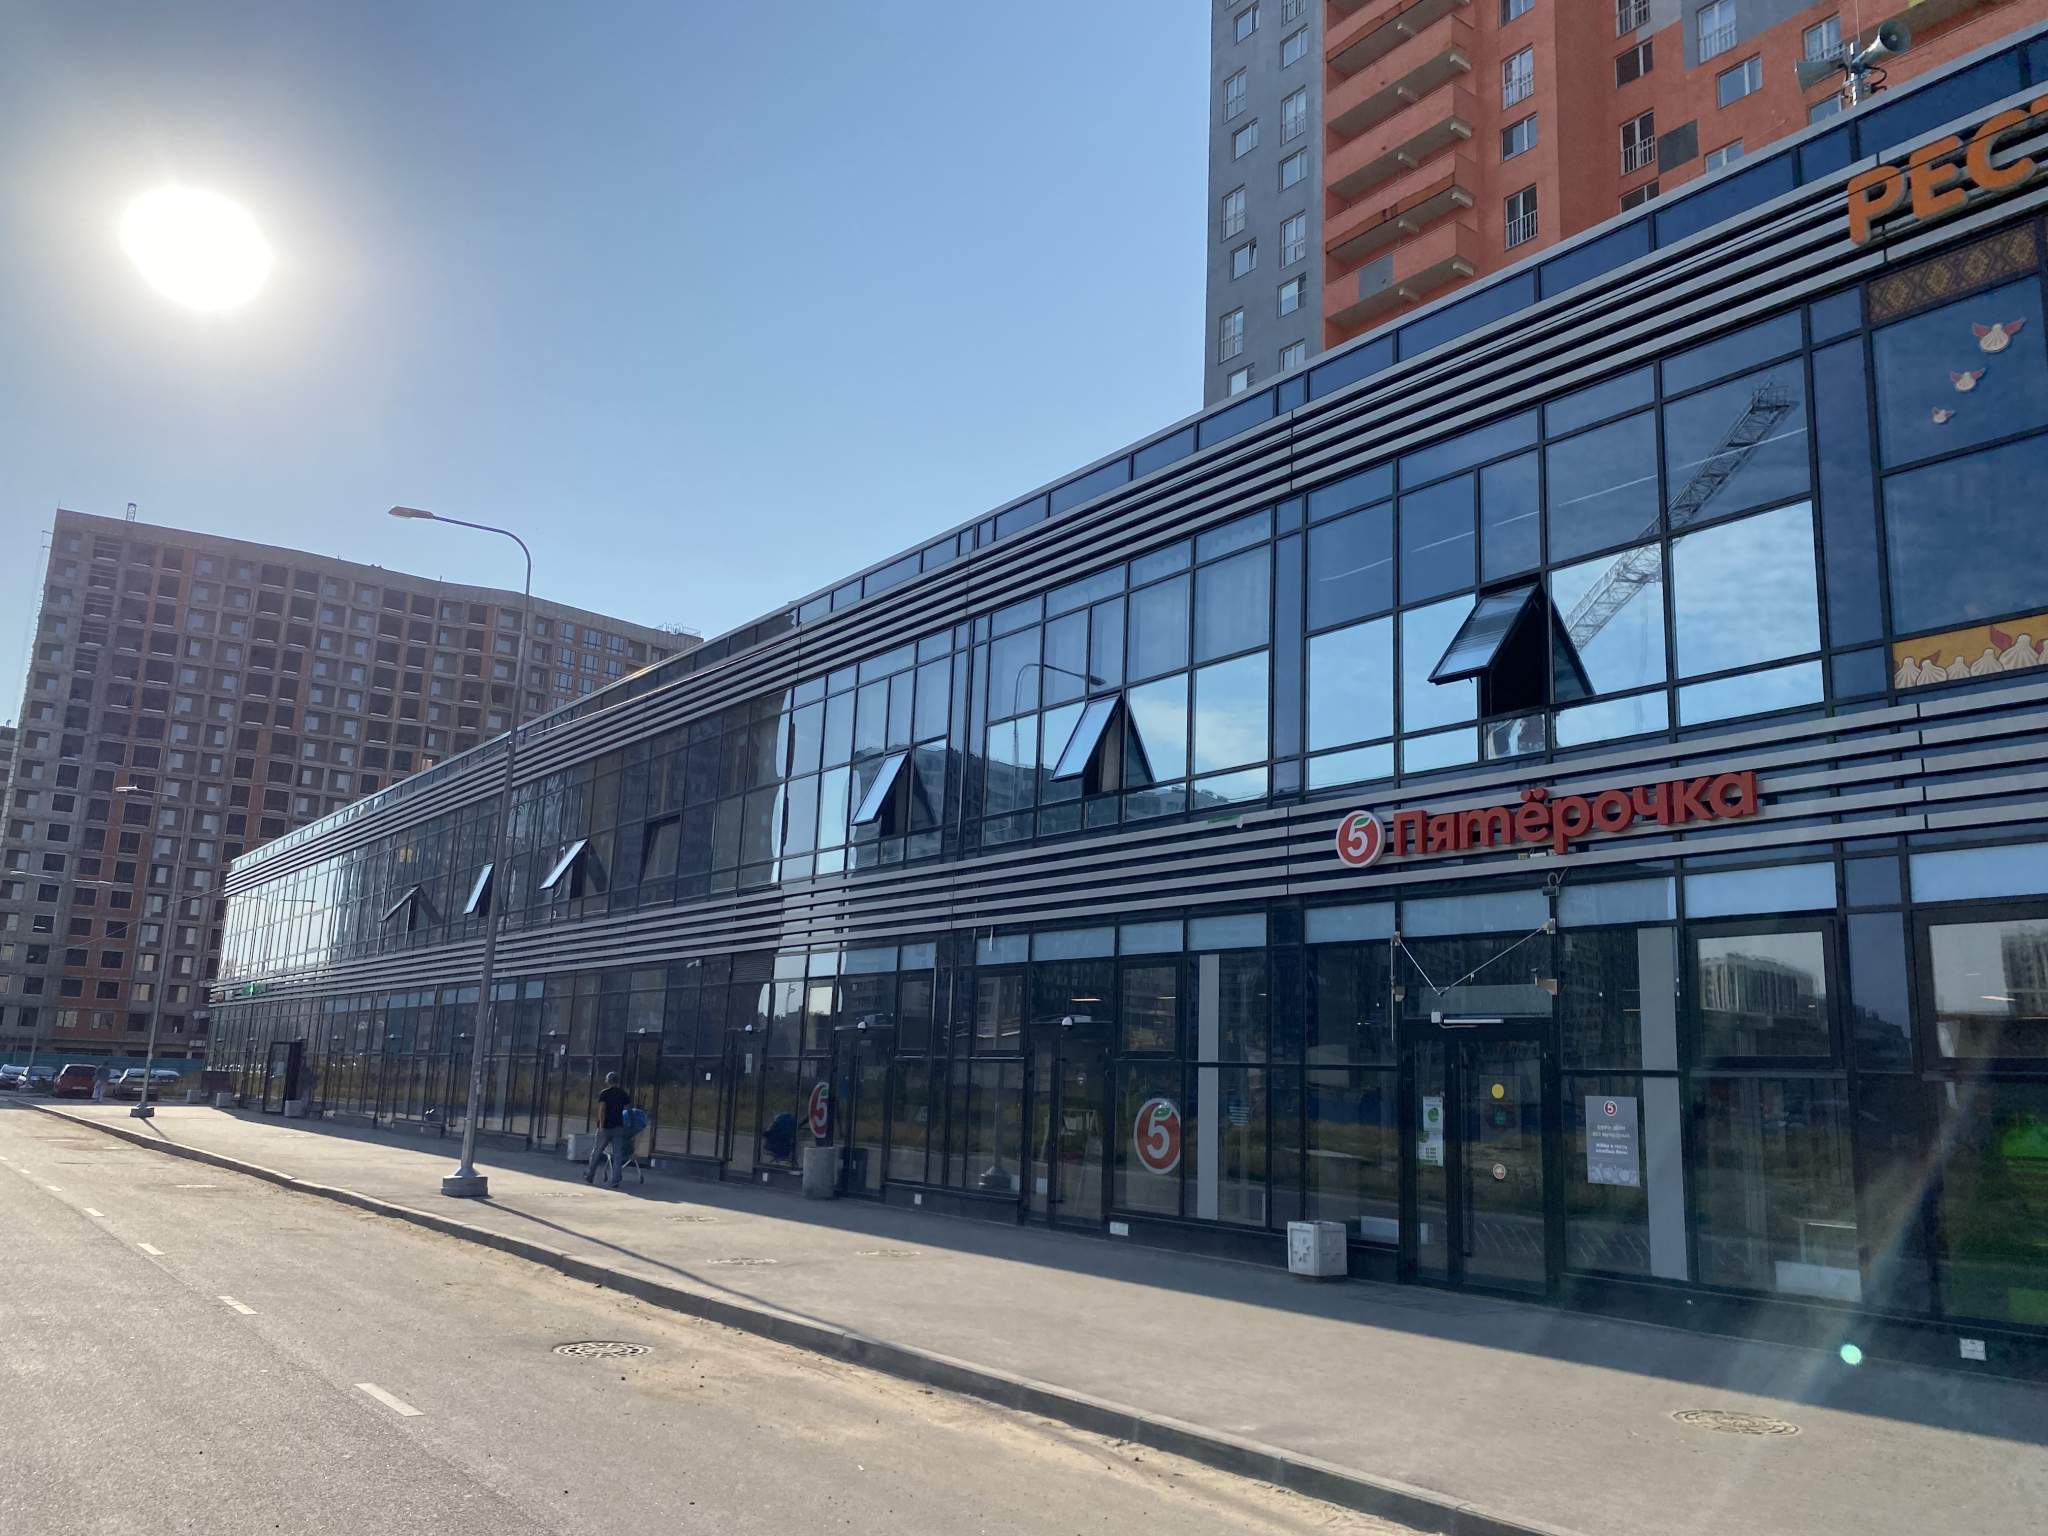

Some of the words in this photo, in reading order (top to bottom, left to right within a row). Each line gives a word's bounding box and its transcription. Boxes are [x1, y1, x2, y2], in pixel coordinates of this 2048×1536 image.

[1847, 95, 2048, 246] РЕС
[1393, 771, 1758, 857] Пятёрочка
[1147, 1105, 1172, 1159] 5
